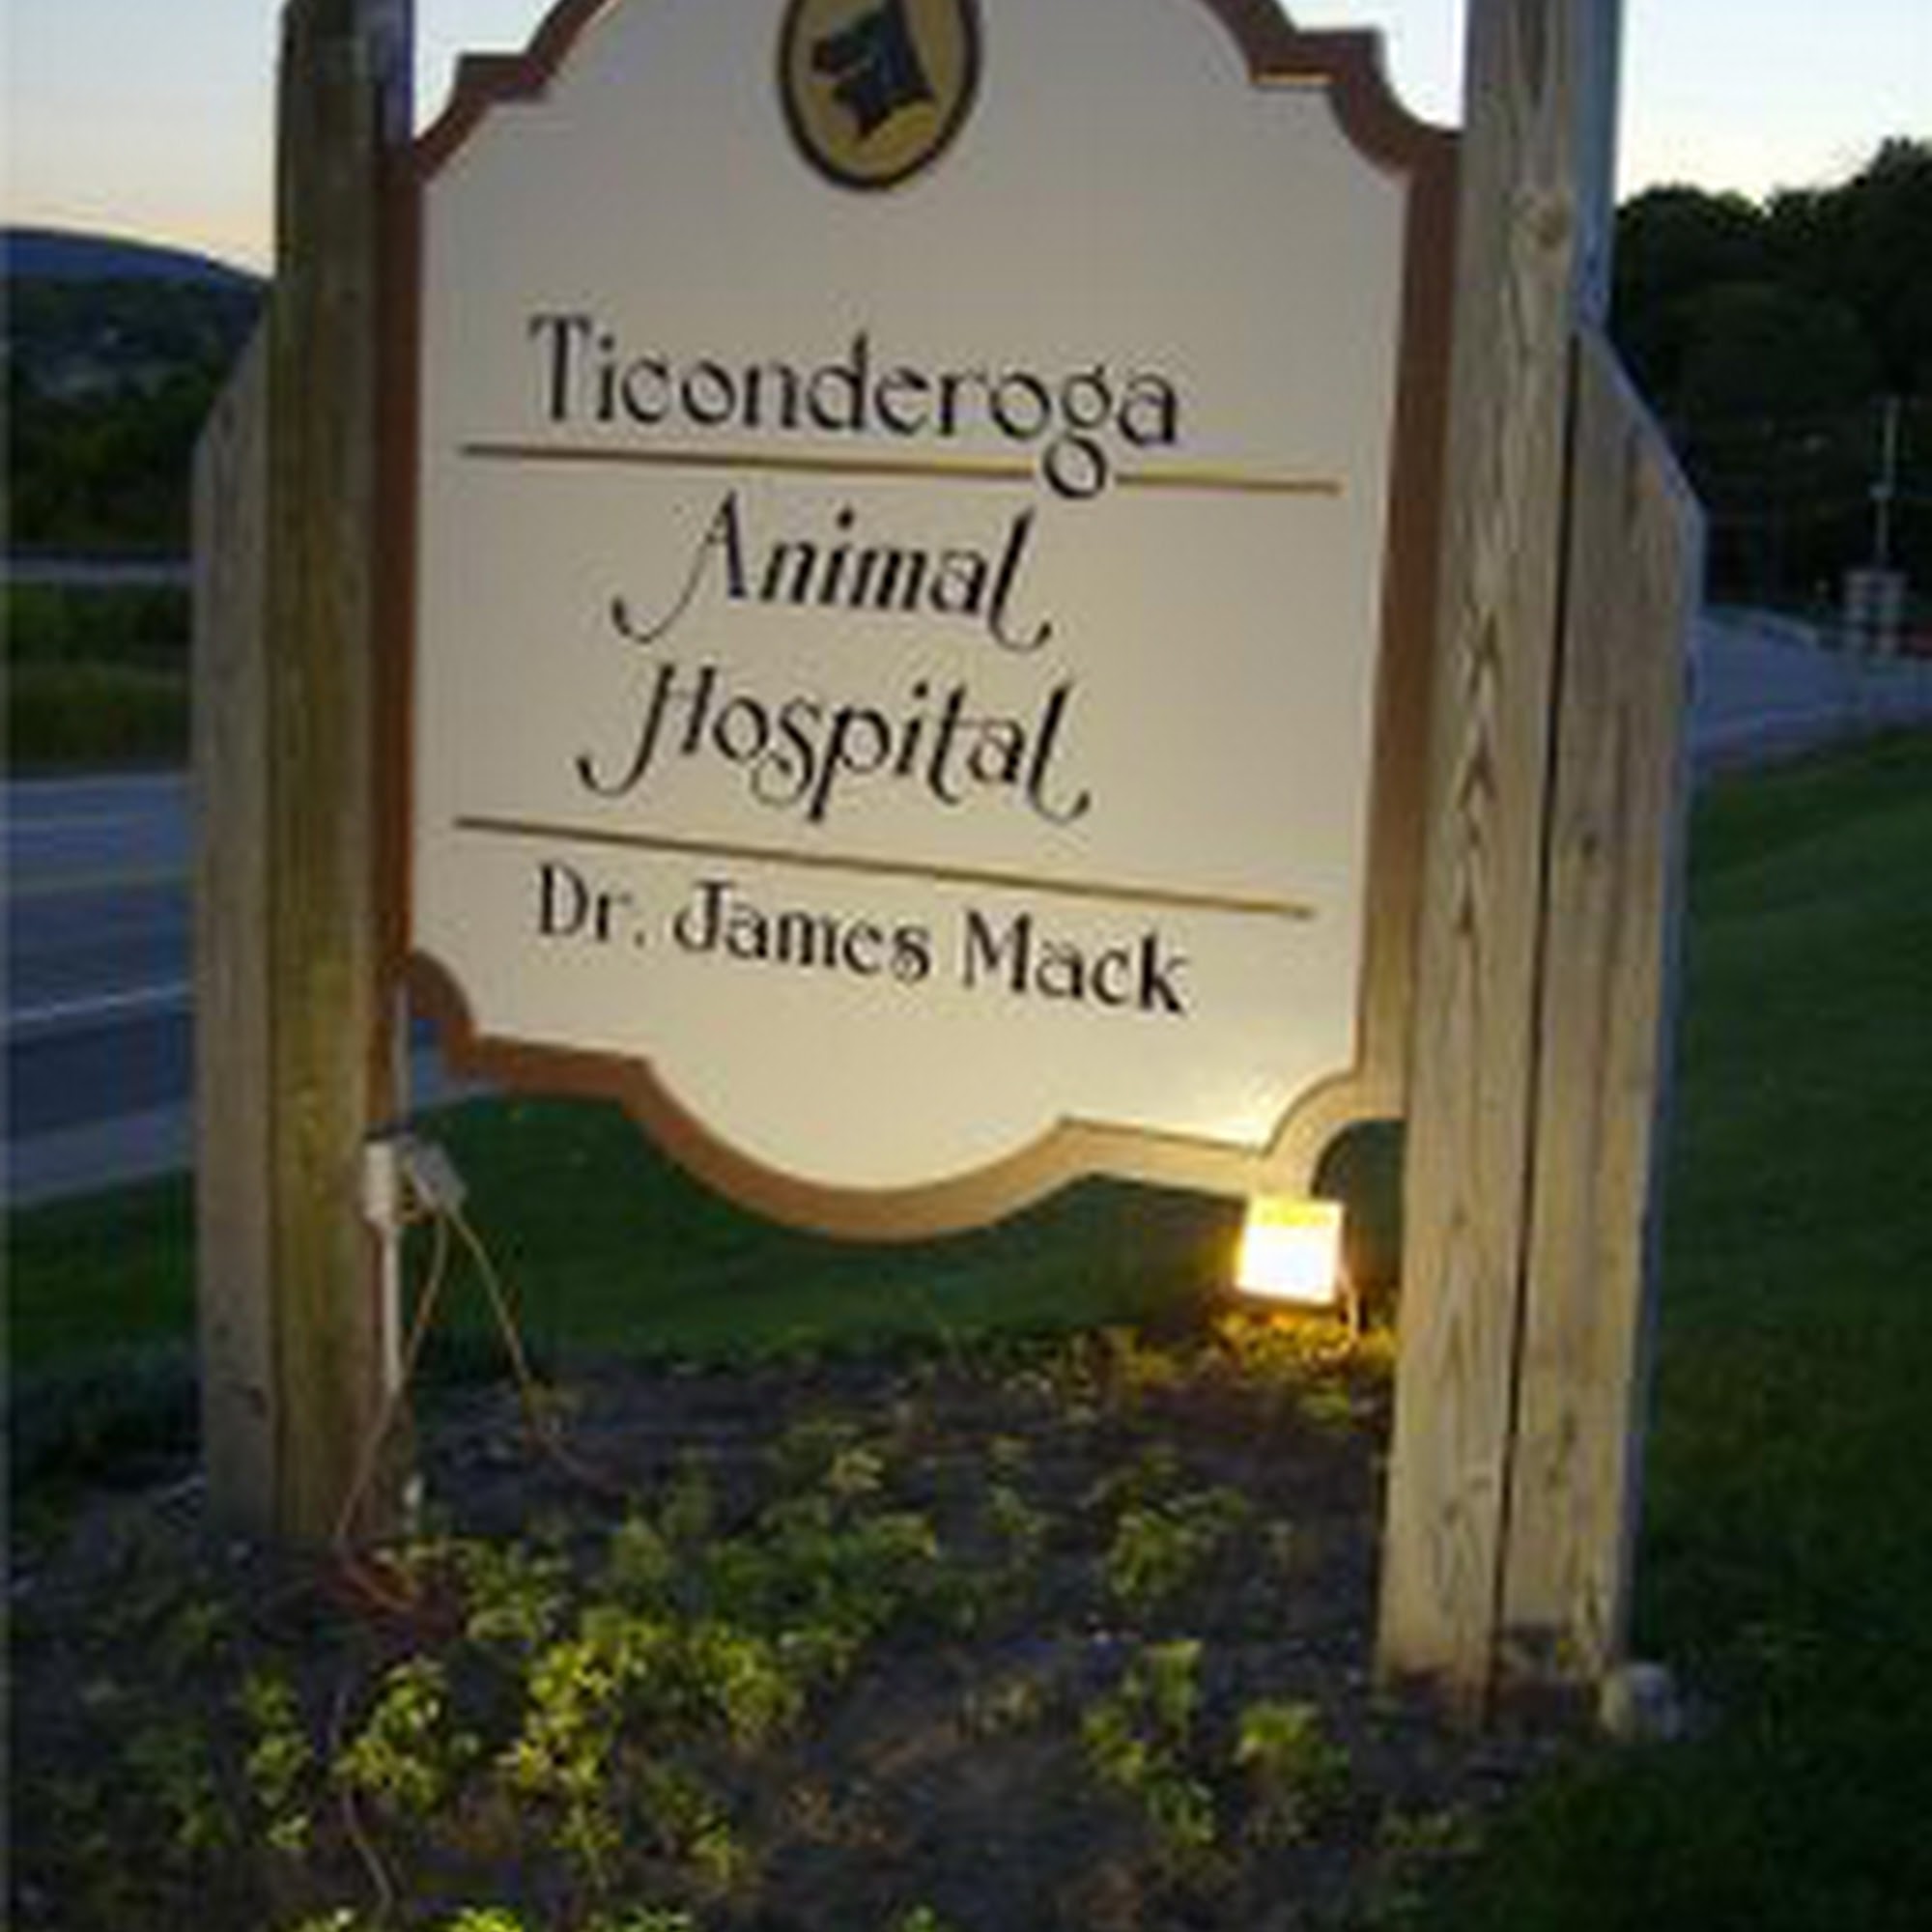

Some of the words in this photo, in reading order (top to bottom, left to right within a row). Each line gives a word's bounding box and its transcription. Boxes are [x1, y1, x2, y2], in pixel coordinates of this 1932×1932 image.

[528, 314, 1180, 501] Ticonderoga
[611, 489, 1054, 652] Animal
[576, 662, 1093, 825] Hospital
[536, 862, 646, 949] Dr.
[672, 878, 933, 985] James
[961, 908, 1188, 1017] Mack
